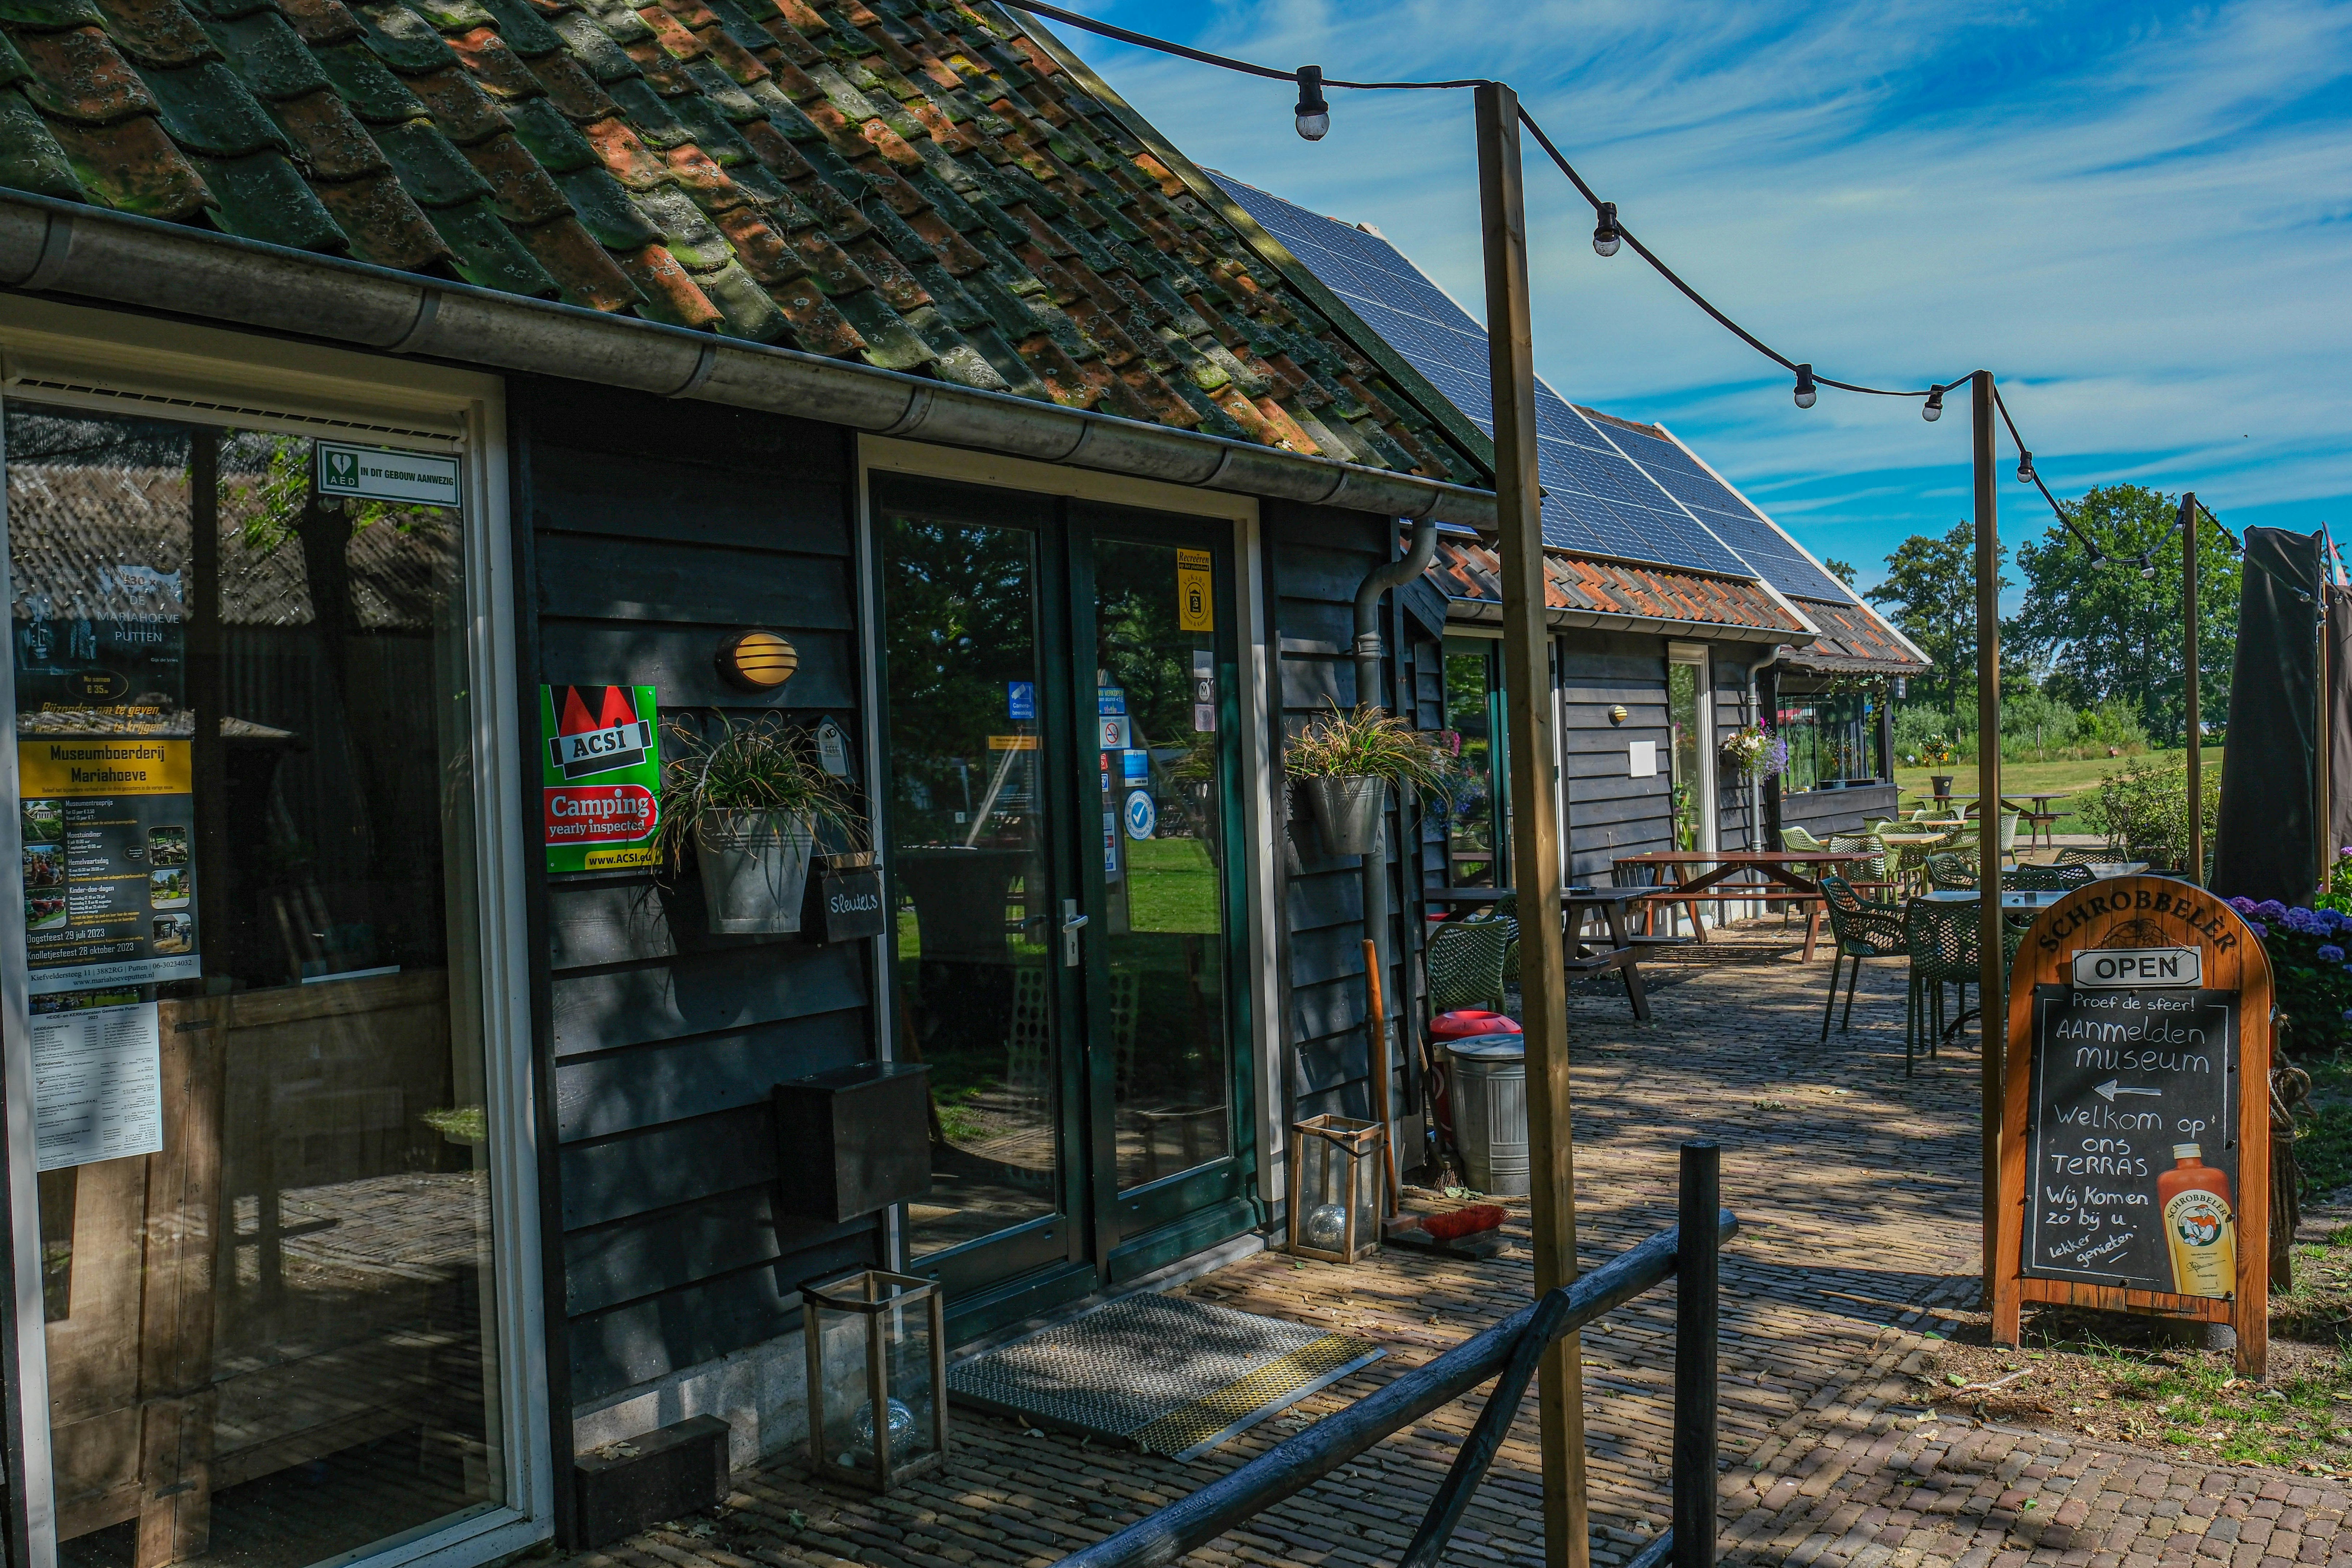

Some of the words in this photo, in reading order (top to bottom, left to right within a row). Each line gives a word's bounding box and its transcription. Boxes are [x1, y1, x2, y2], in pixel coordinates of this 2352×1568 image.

[330, 476, 355, 486] AED
[360, 467, 368, 476] IN
[371, 469, 383, 478] DIT
[384, 470, 415, 481] GEBOUW
[417, 474, 453, 486] AANWEZIG
[1179, 551, 1210, 564] Recreëren
[130, 596, 145, 605] DE
[97, 611, 179, 624] MARIAHOEVE
[115, 631, 162, 642] PUTTEN
[115, 704, 126, 715] te
[127, 705, 161, 717] geven,
[113, 722, 123, 733] te
[51, 744, 165, 762] Museumboerderij
[71, 767, 147, 783] Mariahoeve
[551, 788, 650, 819] Camping
[549, 822, 587, 837] yearly
[588, 819, 645, 835] inspected
[588, 852, 652, 866] www.ACSI.eu
[69, 885, 114, 894] Kinder-doe-dagen
[830, 893, 878, 914] Sleutels
[65, 931, 74, 940] 29
[75, 930, 86, 941] juli
[87, 928, 105, 938] 2023
[27, 948, 77, 961] Knolletjesfeest
[79, 946, 88, 955] 28
[90, 945, 116, 955] oktober
[117, 942, 134, 952] 2023
[31, 971, 82, 981] Kiefveldersteeg
[96, 966, 123, 975] 3882RG
[152, 959, 192, 969] 06-30234032
[2095, 957, 2178, 979] OPEN
[73, 972, 154, 986] www.mariahoeveputten.nl
[2073, 993, 2118, 1009] Proef
[2122, 997, 2141, 1010] de
[2147, 996, 2195, 1012] sfeer!
[2054, 1104, 2162, 1131] Welkom
[2177, 1118, 2206, 1139] op
[2081, 1137, 2131, 1155] ons
[2046, 1185, 2078, 1212] Wij
[2167, 1194, 2227, 1220] SCHROBBELÈR
[2045, 1211, 2071, 1225] zo
[2078, 1207, 2100, 1231] bij
[2111, 1214, 2126, 1226] u
[2049, 1233, 2091, 1259] lekker
[2076, 1232, 2134, 1268] genieten
